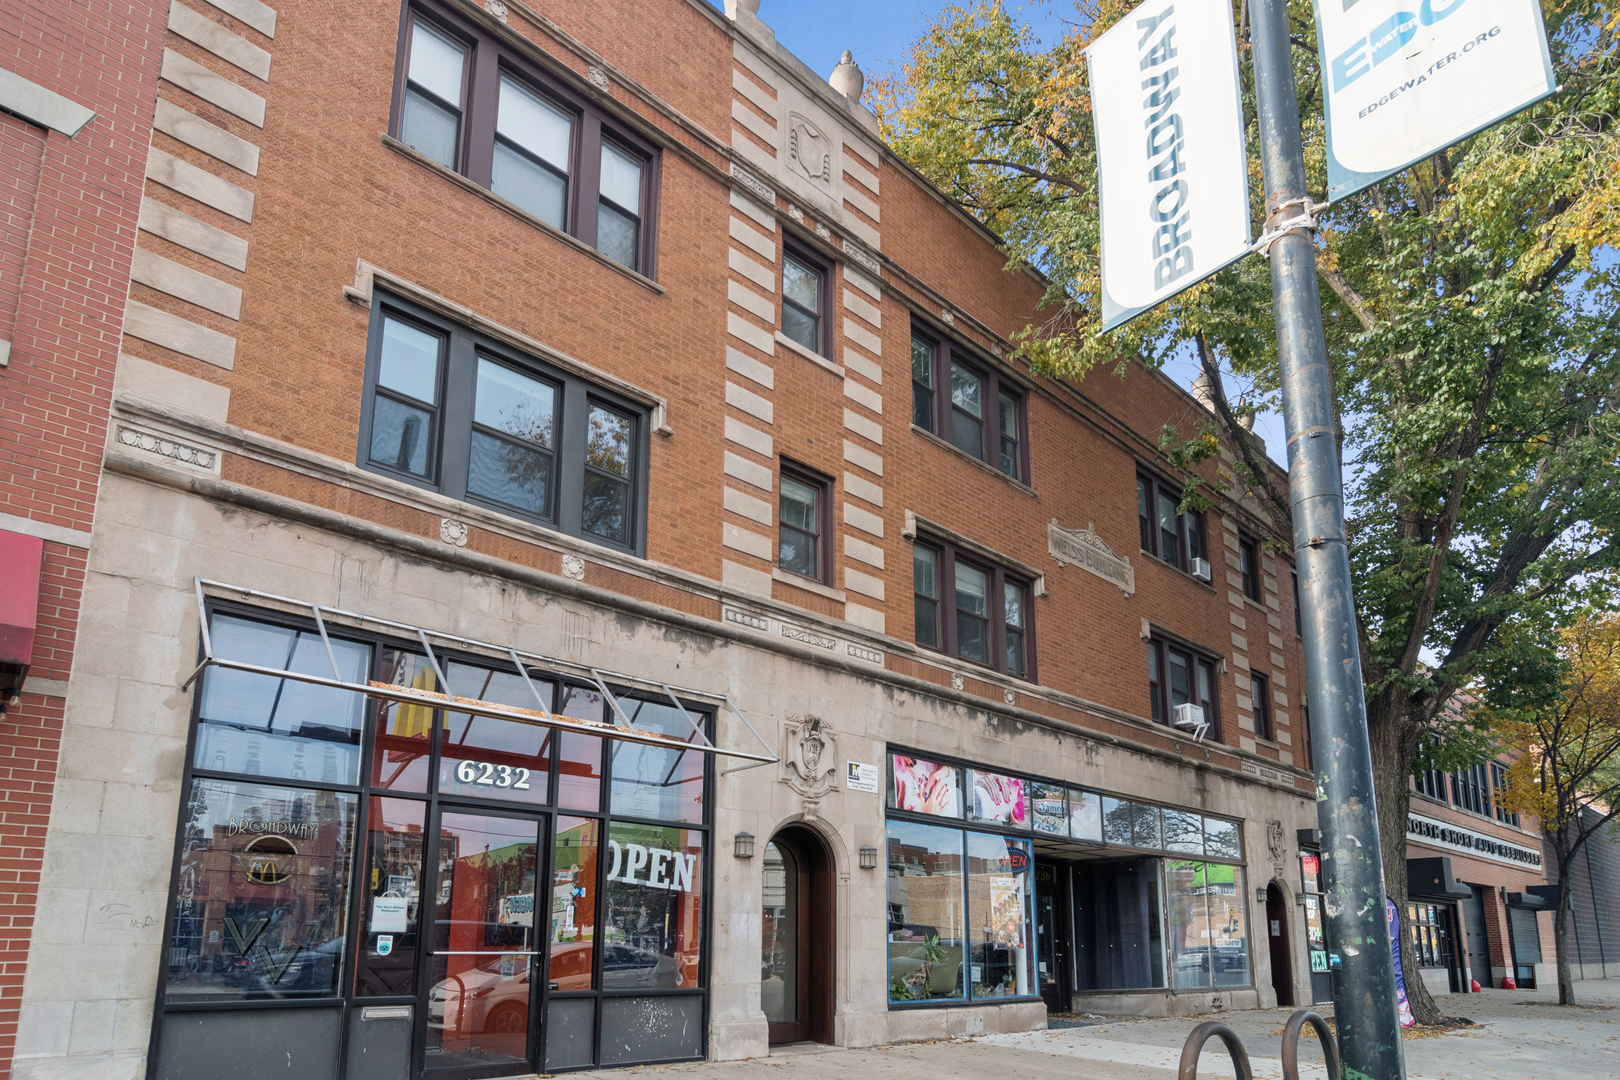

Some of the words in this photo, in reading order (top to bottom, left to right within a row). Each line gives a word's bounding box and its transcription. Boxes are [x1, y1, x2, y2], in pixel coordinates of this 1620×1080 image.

[1371, 18, 1418, 53] WATER
[1358, 25, 1501, 119] EDGEWATER.ORG
[1136, 4, 1194, 291] BROADWAY
[1051, 533, 1084, 563] WEISS
[1086, 550, 1130, 586] BUILDING
[454, 760, 530, 791] 6232
[229, 817, 317, 841] BROADWAY
[1406, 817, 1441, 839] NORTH
[1443, 828, 1475, 848] SHORE
[1477, 838, 1499, 855] AUTO
[1500, 844, 1541, 867] REBUILDERS
[997, 855, 1027, 867] OPEN
